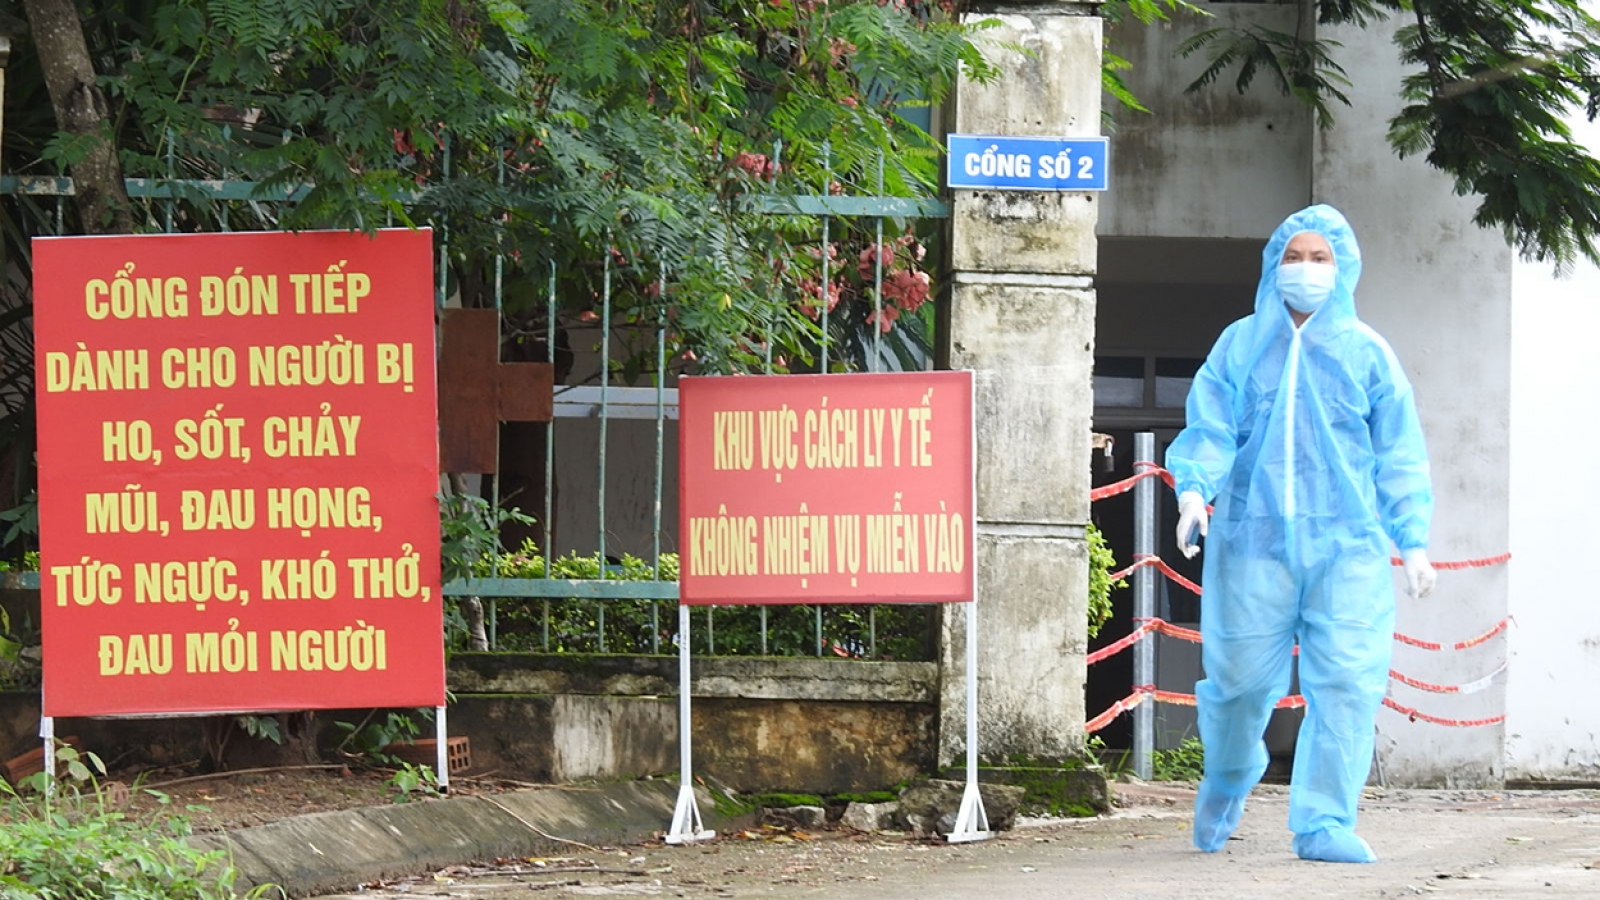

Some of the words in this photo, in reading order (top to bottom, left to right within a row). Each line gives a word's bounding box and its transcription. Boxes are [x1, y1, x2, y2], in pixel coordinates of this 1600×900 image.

[964, 144, 1031, 178] CỔNG
[1038, 148, 1072, 179] SỐ
[1078, 156, 1094, 179] 2
[85, 262, 188, 320] CỔNG
[199, 267, 278, 316] ĐÓN
[289, 260, 371, 314] TIẾP
[46, 342, 149, 392] DÀNH
[161, 349, 236, 389] CHO
[249, 334, 364, 386] NGƯỜI
[377, 343, 414, 392] BỊ
[103, 419, 162, 466] HO,
[174, 403, 251, 462] SỐT,
[263, 402, 361, 457] CHẢY
[713, 411, 754, 470] KHU
[759, 404, 798, 483] VỰC
[804, 396, 858, 469] CÁCH
[863, 408, 885, 467] LY
[891, 408, 903, 467] Y
[908, 388, 933, 467] TẾ
[85, 484, 170, 537] MŨI,
[181, 489, 255, 531] ĐAU
[268, 487, 382, 537] HỌNG,
[690, 504, 758, 576] KHÔNG
[763, 502, 829, 588] NHIỆM
[834, 515, 860, 587] VỤ
[866, 492, 919, 574] MIỄN
[923, 501, 964, 574] VÀO
[51, 556, 122, 607] TỨC
[135, 556, 249, 611] NGỰC,
[261, 550, 337, 600] KHÓ
[348, 543, 430, 603] THỞ,
[99, 634, 173, 676] ĐAU
[186, 618, 257, 673] MỎI
[271, 619, 386, 672] NGƯỜI
